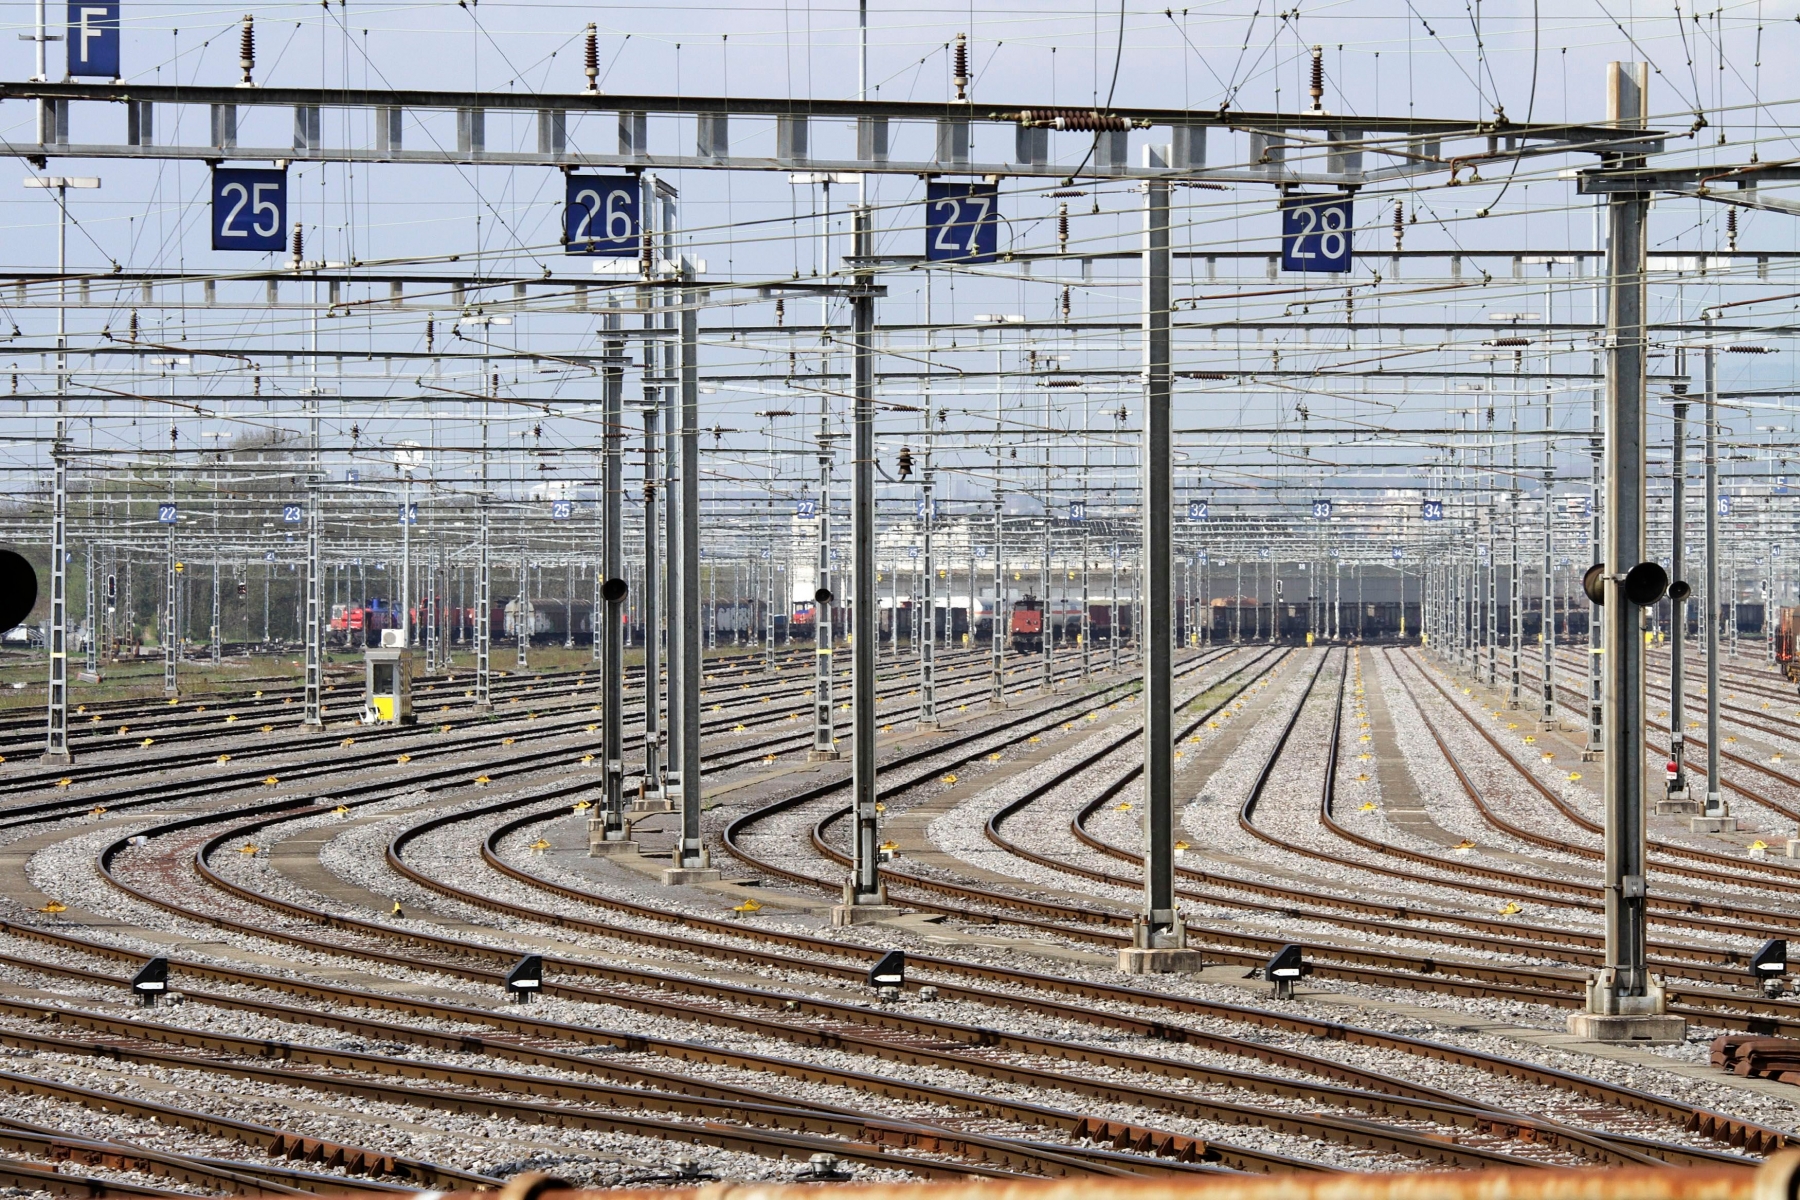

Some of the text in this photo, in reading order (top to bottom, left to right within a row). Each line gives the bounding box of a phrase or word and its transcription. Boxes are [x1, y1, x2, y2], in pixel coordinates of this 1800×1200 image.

[80, 8, 107, 62] F
[220, 183, 280, 237] 25
[575, 189, 632, 243] 26
[934, 197, 991, 250] 27
[1290, 206, 1347, 259] 28
[160, 507, 175, 520] 22
[285, 507, 301, 520] 23
[554, 503, 569, 517] 25
[798, 502, 814, 516] 27
[1071, 504, 1084, 517] 31
[1190, 503, 1206, 516] 32
[1314, 503, 1329, 516] 33
[1424, 503, 1440, 517] 34
[1393, 549, 1403, 557] 34
